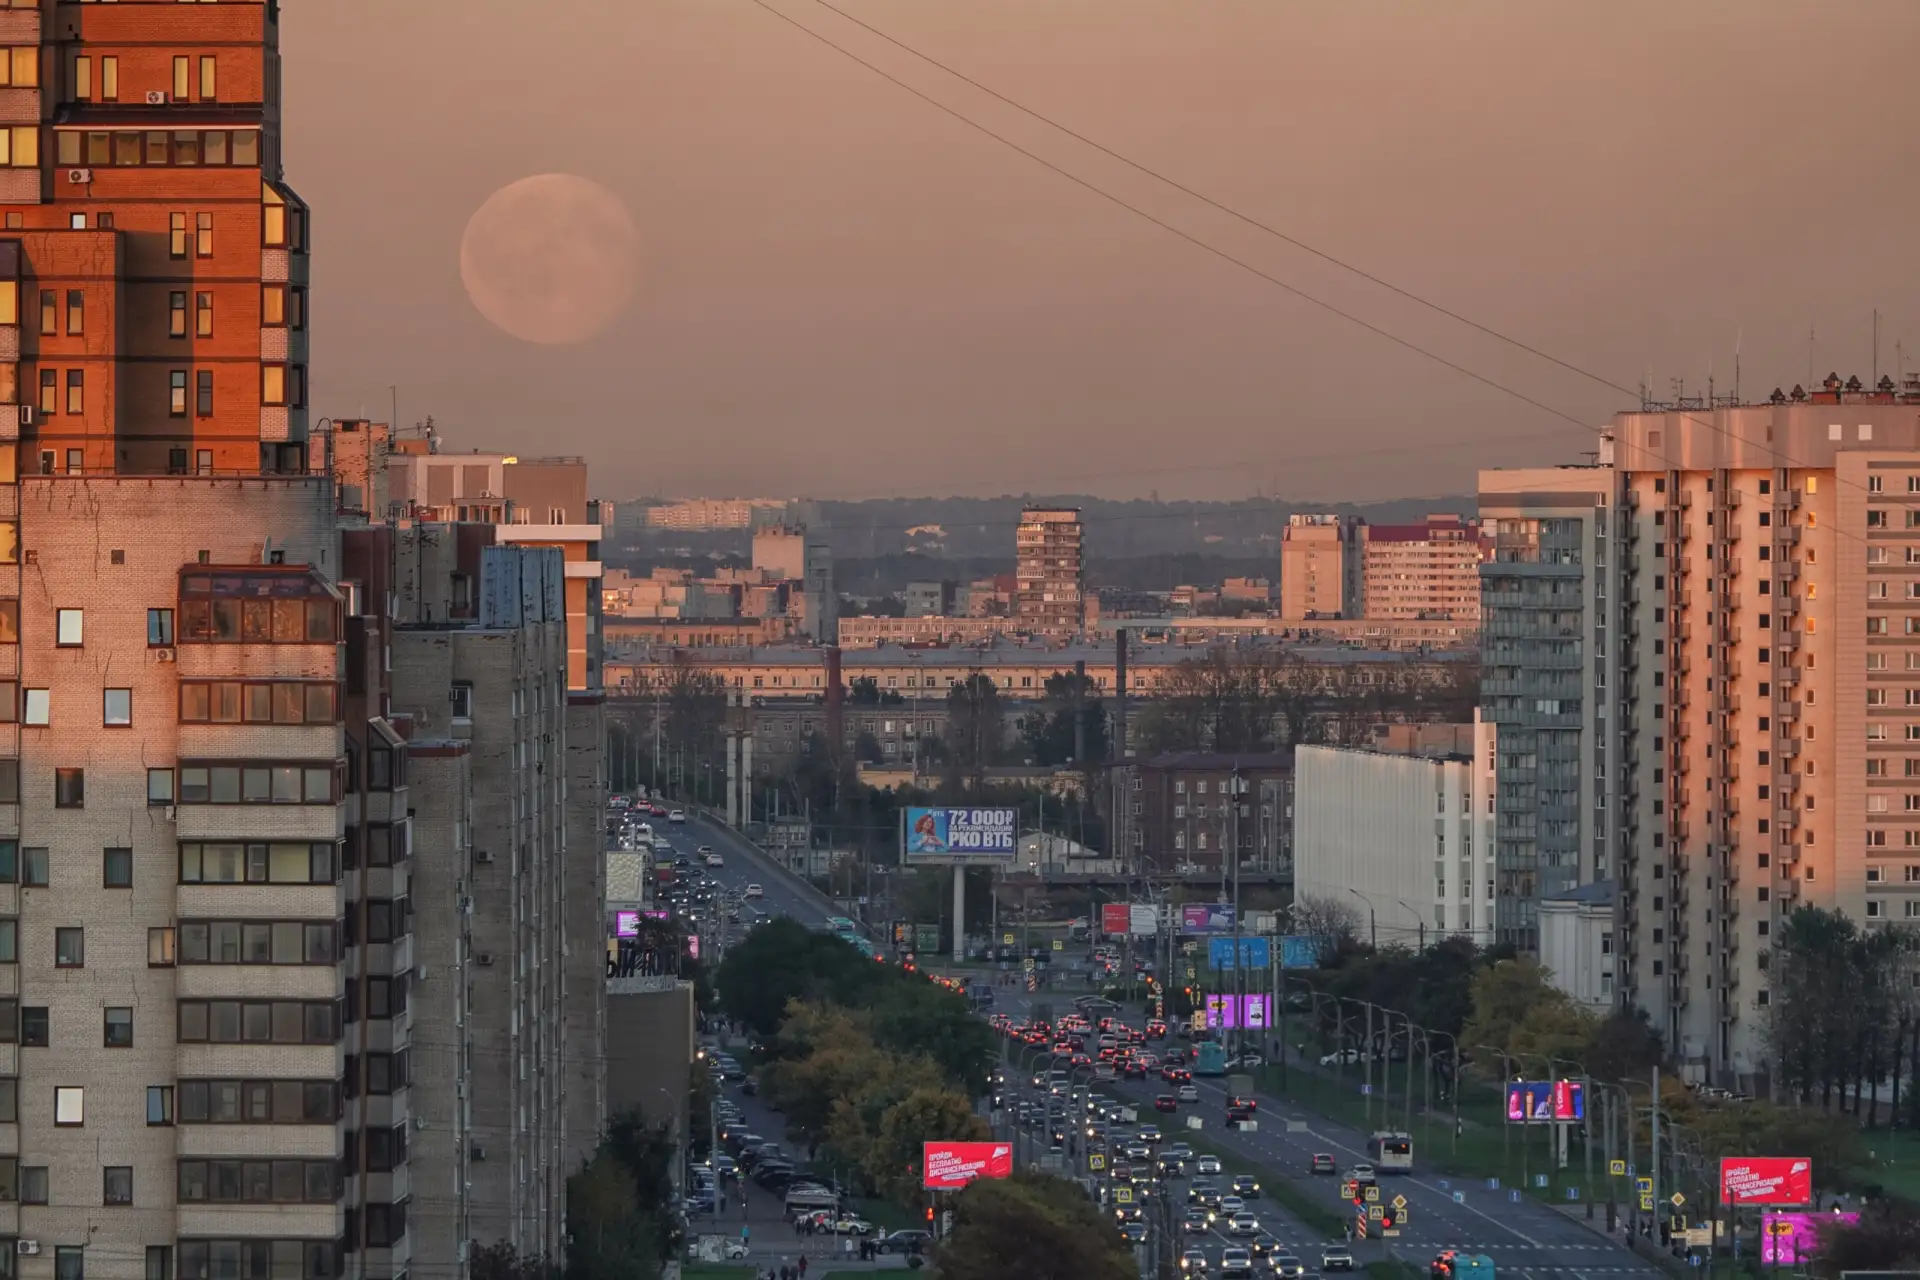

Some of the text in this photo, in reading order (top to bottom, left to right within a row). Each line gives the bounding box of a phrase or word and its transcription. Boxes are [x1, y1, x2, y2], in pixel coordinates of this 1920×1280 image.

[948, 810, 1013, 825] 72 000₽
[949, 832, 1013, 847] РКО ВТБ
[929, 1151, 952, 1161] ПРОЙДИ
[929, 1157, 961, 1169] БЕСПЛАТНО
[929, 1161, 985, 1177] ДИСПАНСЕРИЗАЦИЮ
